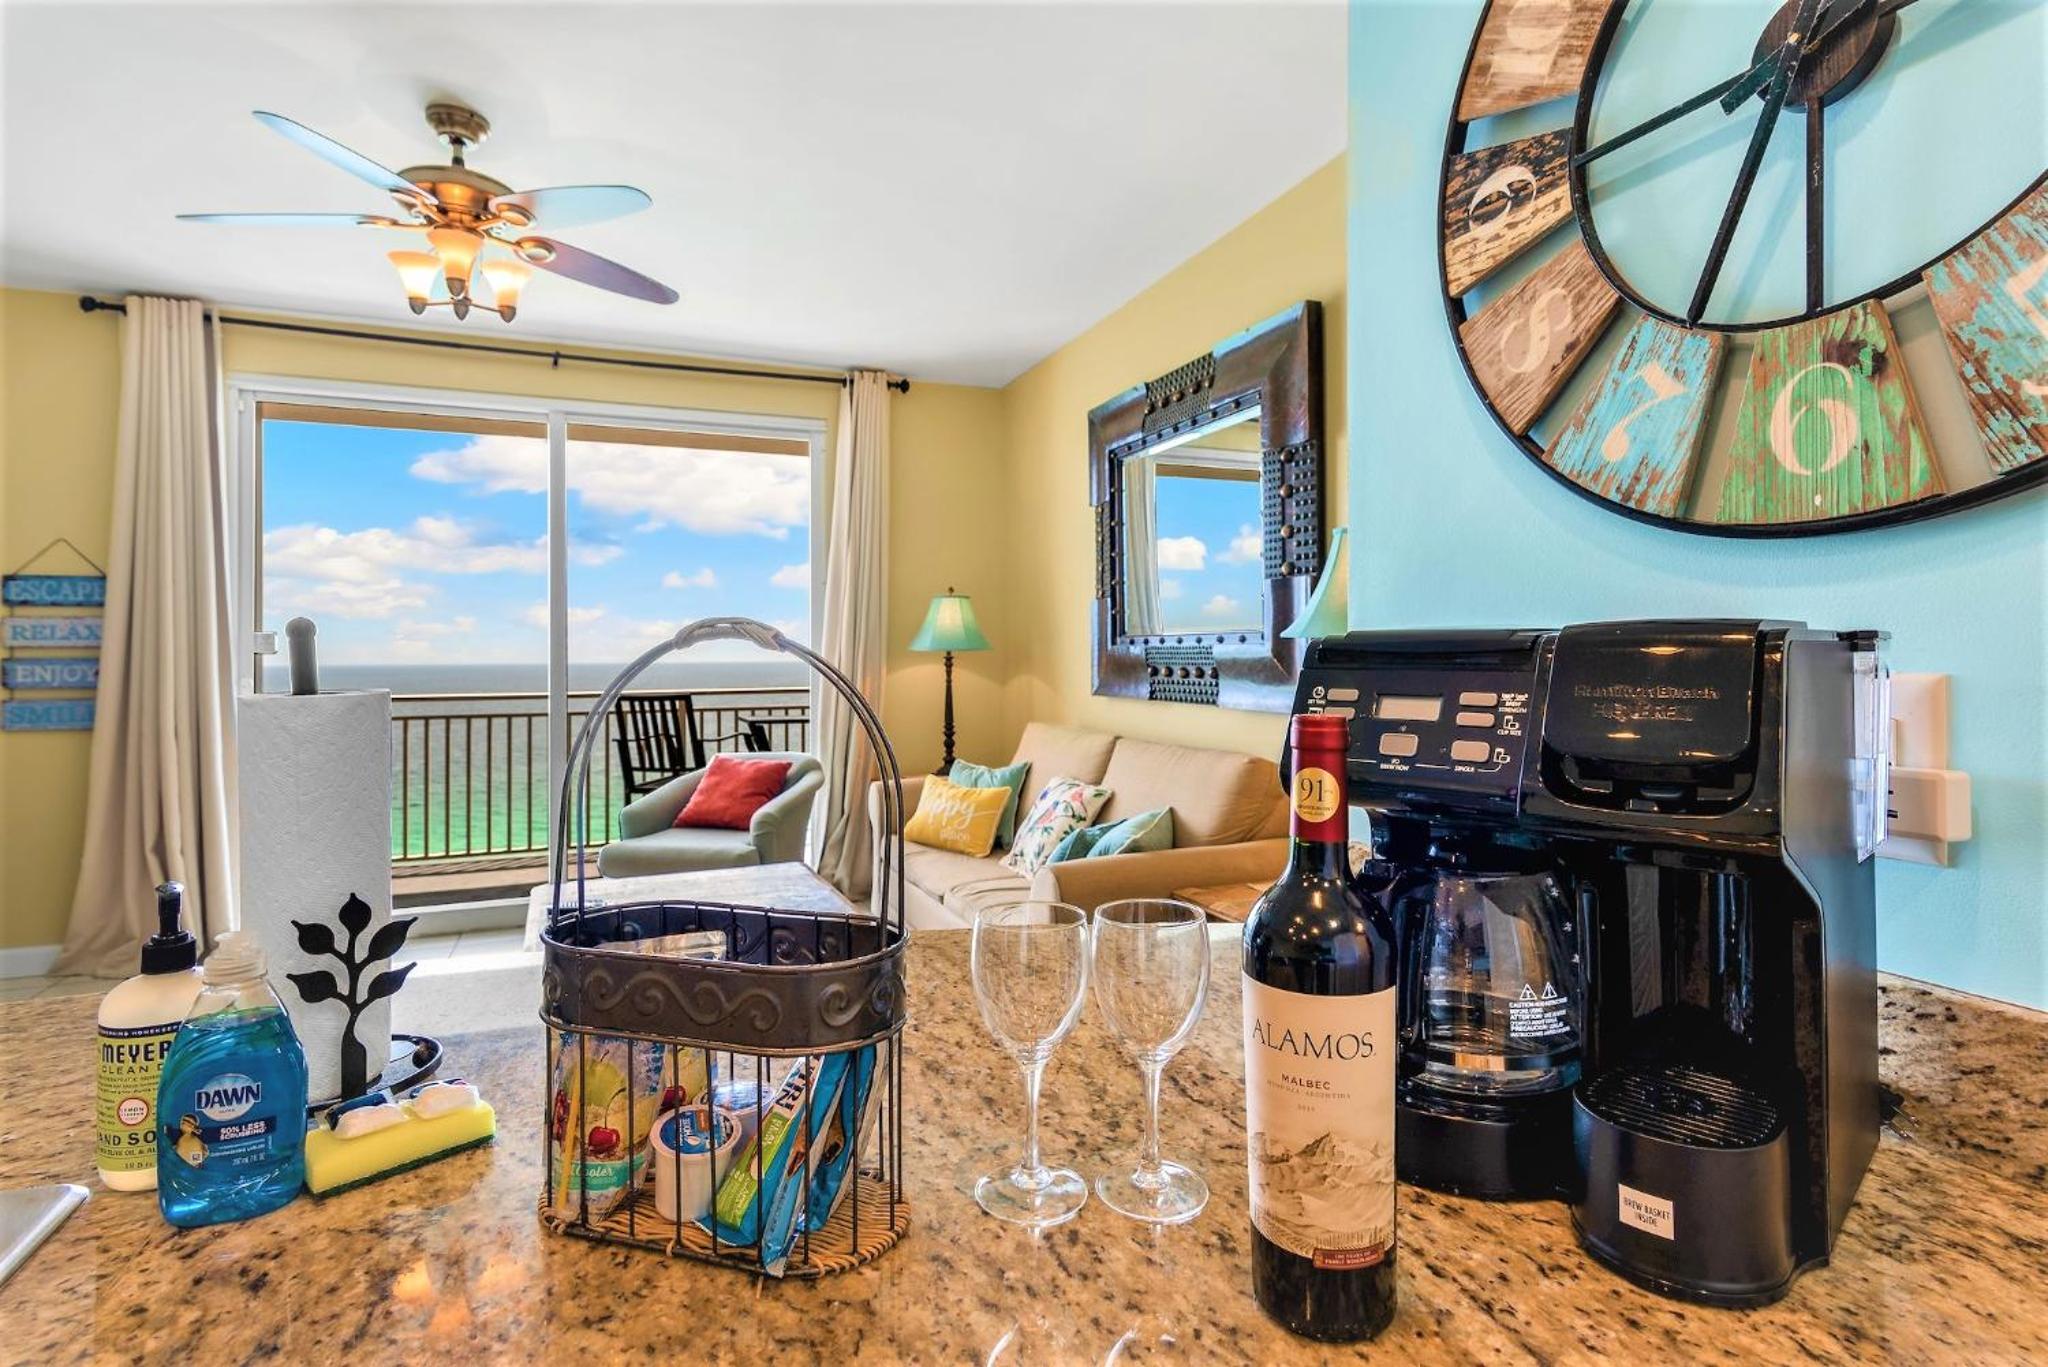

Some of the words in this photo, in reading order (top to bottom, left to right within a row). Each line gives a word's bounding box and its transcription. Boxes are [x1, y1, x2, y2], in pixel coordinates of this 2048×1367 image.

[1468, 164, 1538, 232] 9
[1500, 287, 1574, 374] 8
[1601, 361, 1687, 463] 7
[1770, 361, 1858, 477] 6
[11, 624, 102, 641] RELAX
[15, 664, 97, 686] ENJOY
[1301, 778, 1323, 802] 91
[1252, 1018, 1376, 1061] ALAMOS
[196, 1083, 261, 1110] DAWN
[1281, 1073, 1331, 1091] MALBEC
